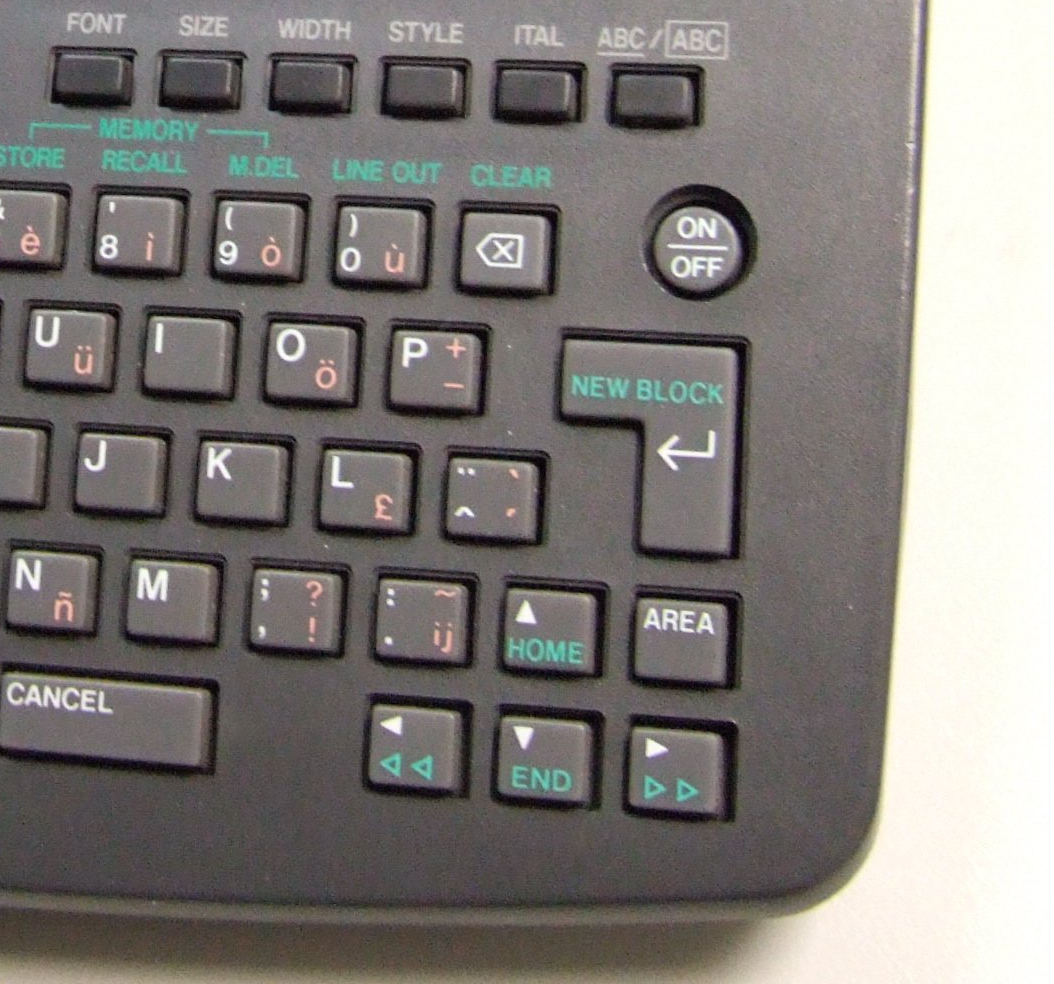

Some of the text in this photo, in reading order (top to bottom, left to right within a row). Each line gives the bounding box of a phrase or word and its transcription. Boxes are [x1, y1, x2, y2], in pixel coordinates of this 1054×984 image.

[66, 13, 128, 35] FONT
[179, 15, 229, 39] SIZE
[278, 18, 352, 42] WIDTH
[388, 21, 464, 44] STYLE
[514, 24, 565, 47] ITAL
[99, 119, 200, 142] MEMORY
[101, 150, 188, 174] RECALL
[229, 155, 301, 179] M.DEL
[332, 161, 444, 185] LINE OUT
[470, 165, 554, 188] CLEAR
[677, 216, 718, 240] ON
[99, 235, 119, 260] 8
[219, 239, 239, 266] 9
[670, 255, 725, 279] OFF
[34, 316, 60, 348] U
[275, 328, 307, 362] O
[401, 337, 430, 368] P
[571, 374, 724, 404] NEW BLOCK
[84, 441, 107, 473] J
[206, 447, 233, 481] K
[331, 454, 355, 489] L
[15, 558, 42, 592] N
[137, 568, 170, 602] M
[305, 580, 323, 607] ?
[644, 607, 715, 635] AREA
[508, 637, 584, 664] HOME
[6, 683, 114, 715] CANCEL
[512, 766, 573, 793] END
